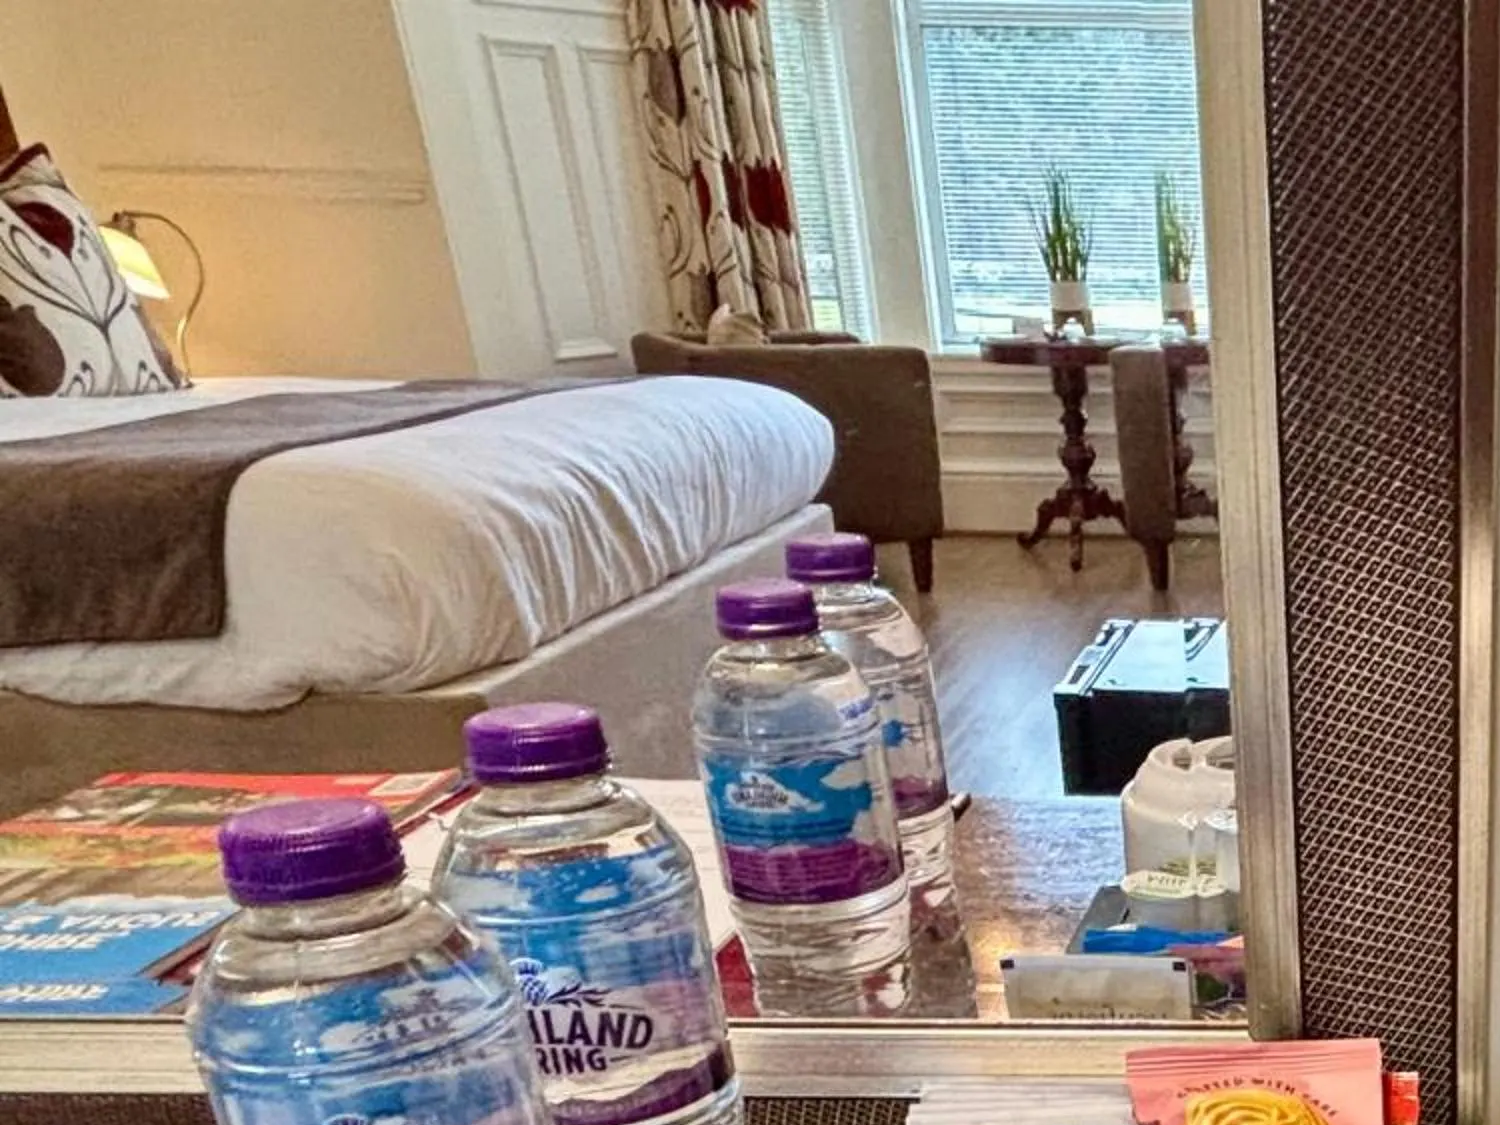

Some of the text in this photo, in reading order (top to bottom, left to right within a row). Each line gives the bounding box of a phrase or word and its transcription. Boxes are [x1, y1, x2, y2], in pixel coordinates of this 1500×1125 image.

[527, 1009, 654, 1050] LAND
[535, 1047, 608, 1075] RING
[1252, 1079, 1297, 1095] WITH
